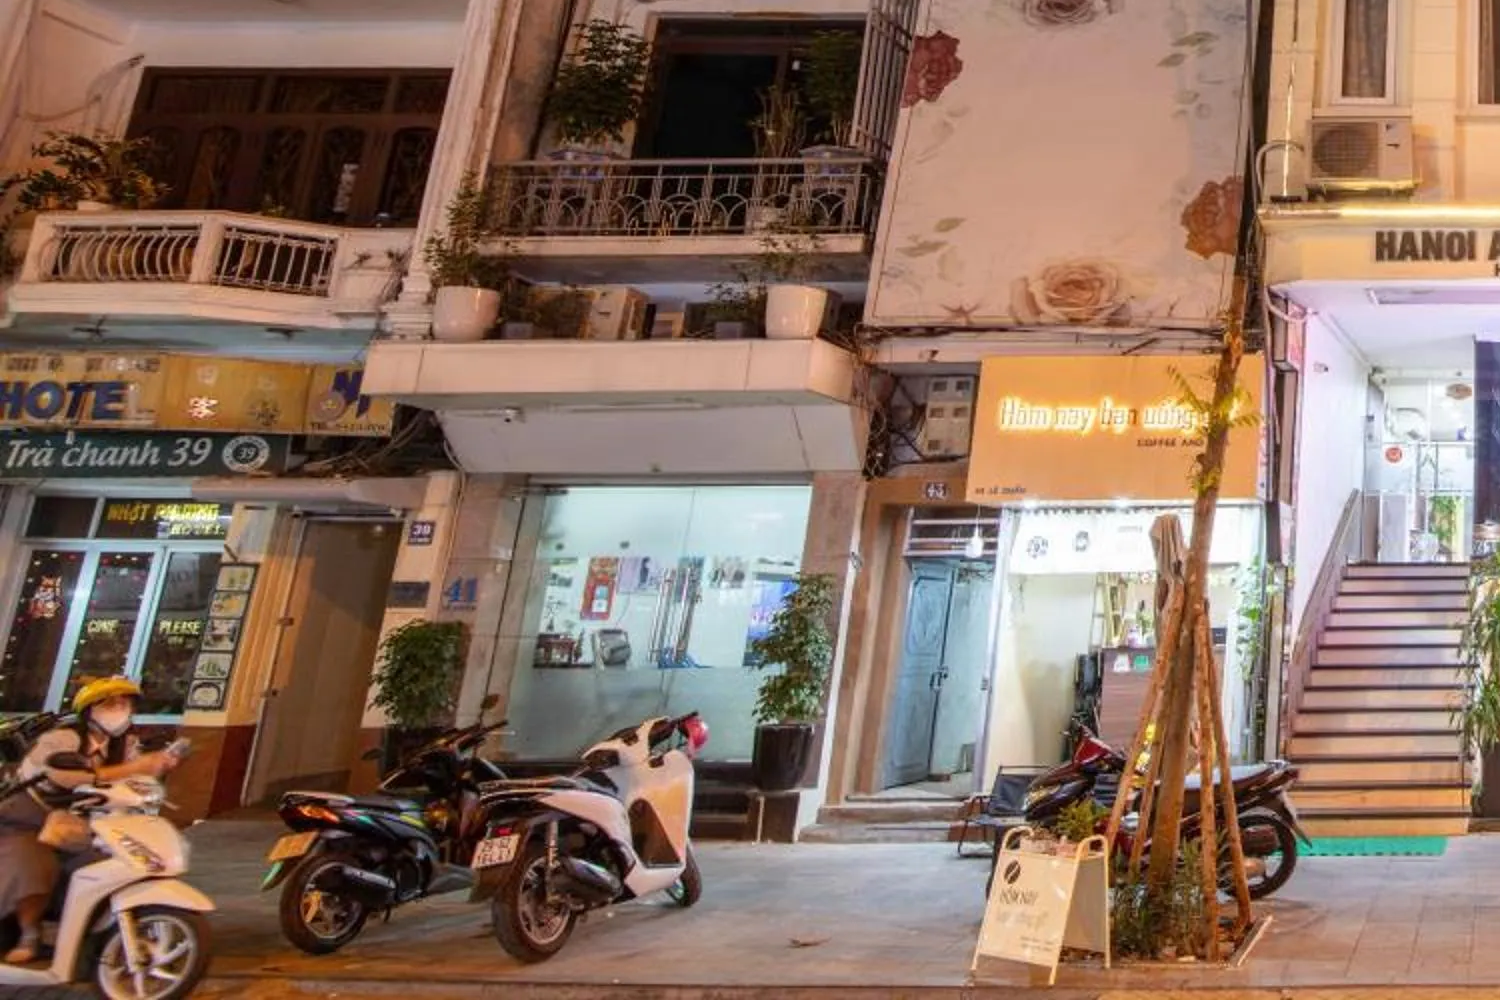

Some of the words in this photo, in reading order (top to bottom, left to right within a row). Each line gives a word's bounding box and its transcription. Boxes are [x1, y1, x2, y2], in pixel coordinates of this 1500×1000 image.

[1375, 230, 1477, 262] HANOI
[6, 439, 55, 468] Trà
[61, 439, 161, 468] chanh
[167, 437, 213, 467] 39
[442, 576, 478, 601] 41
[159, 619, 201, 635] PLEASE
